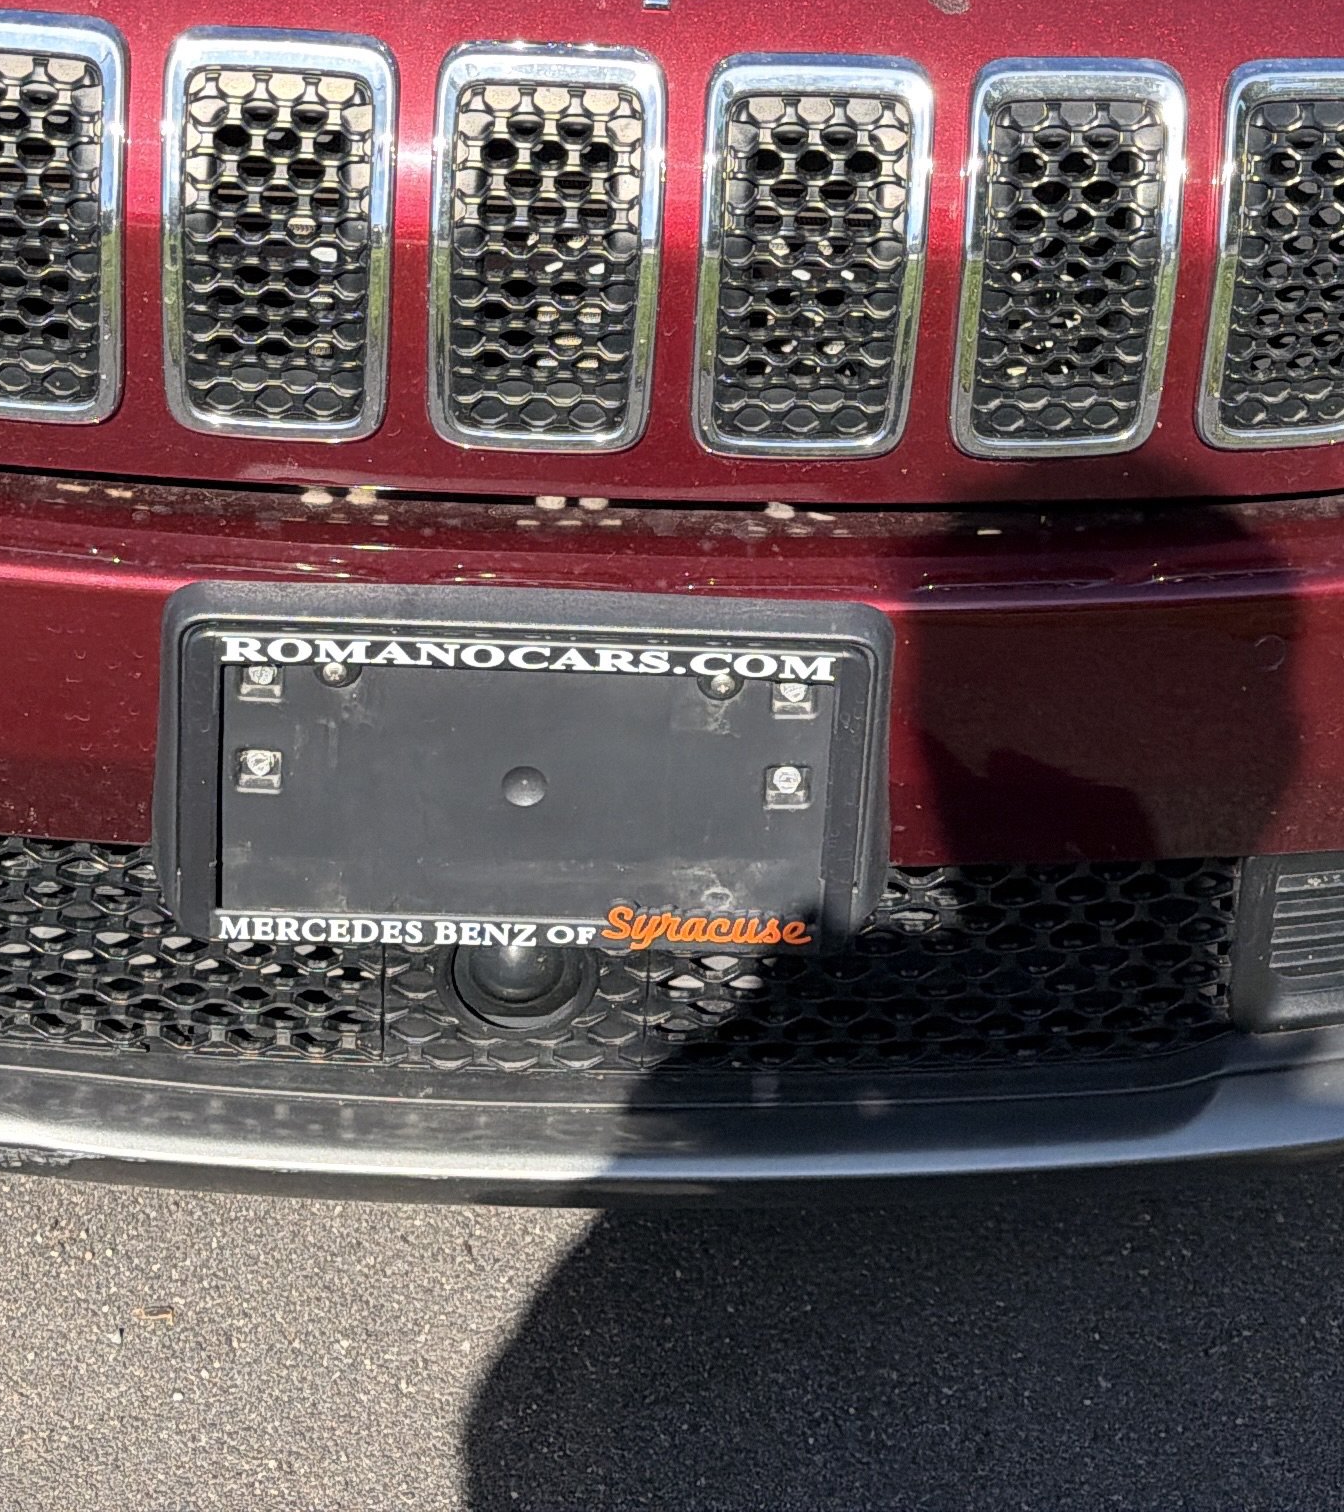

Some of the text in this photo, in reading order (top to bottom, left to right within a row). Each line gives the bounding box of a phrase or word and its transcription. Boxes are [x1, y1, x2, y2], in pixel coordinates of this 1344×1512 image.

[220, 636, 836, 682] ROMANOCARS.COM
[219, 905, 812, 951] MERCEDES BENZ OF Syracuse
